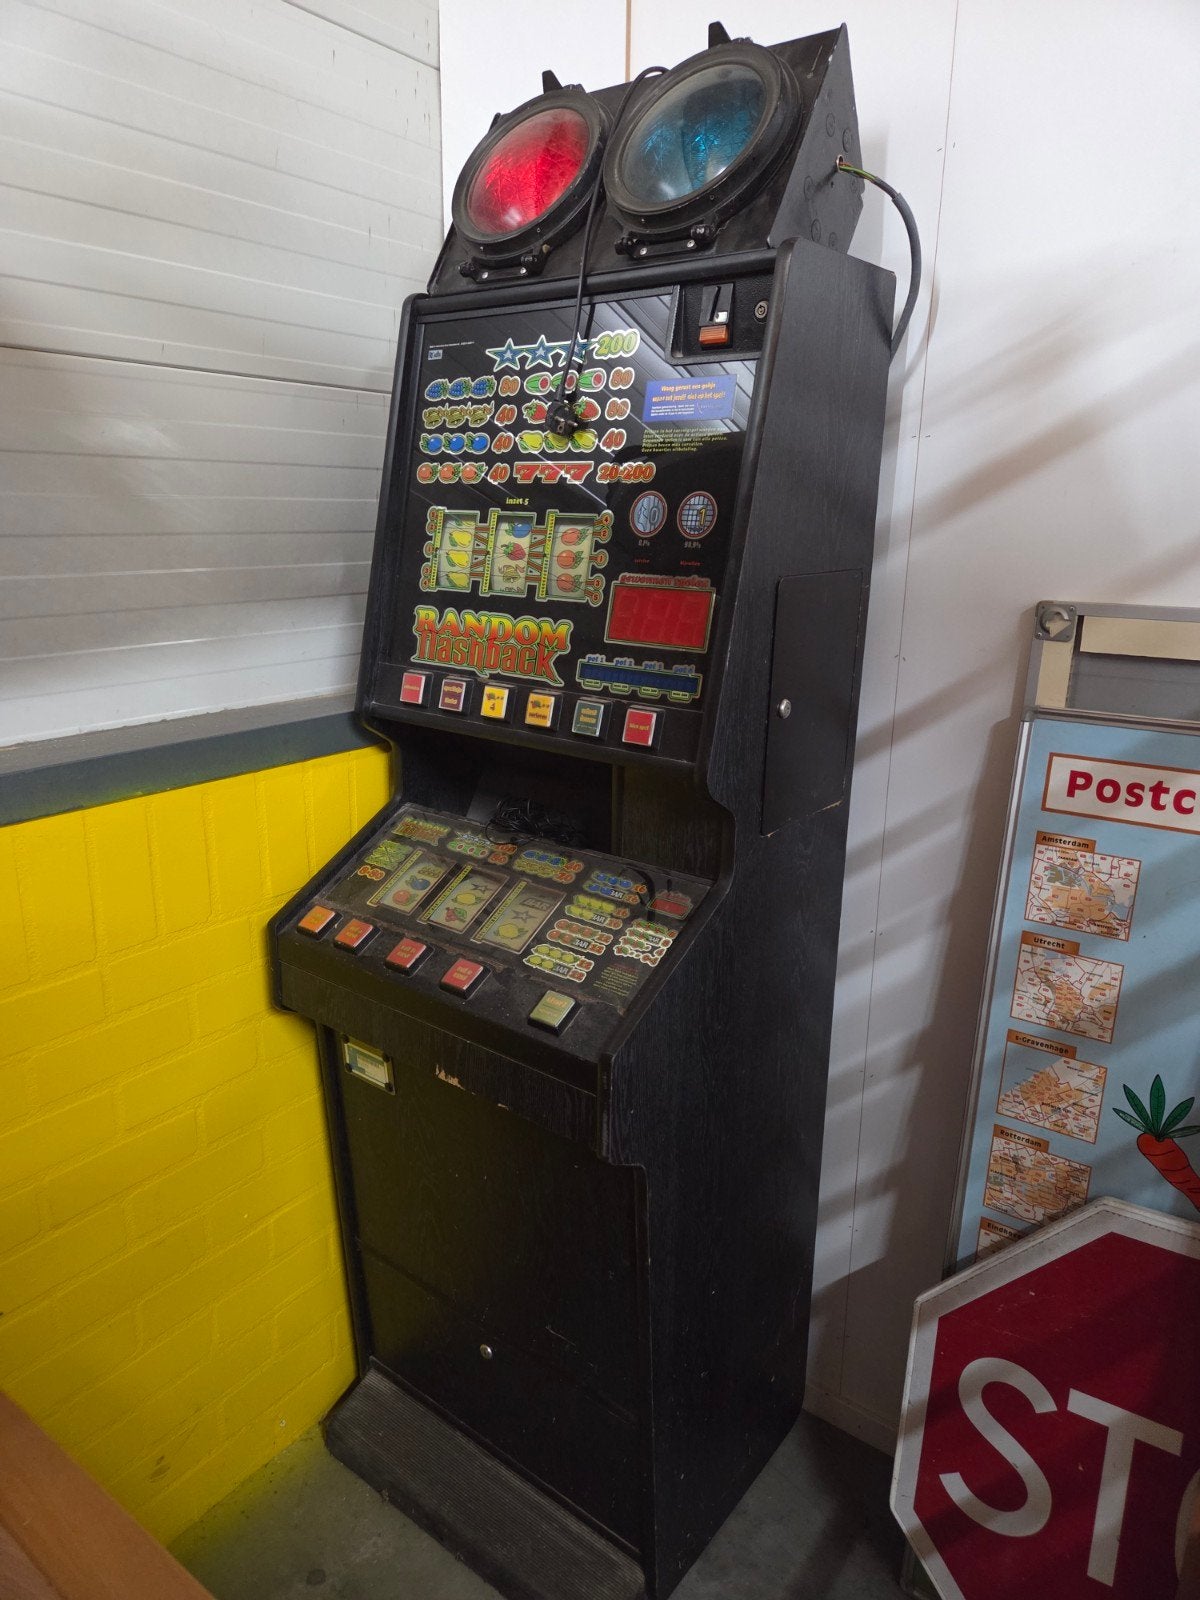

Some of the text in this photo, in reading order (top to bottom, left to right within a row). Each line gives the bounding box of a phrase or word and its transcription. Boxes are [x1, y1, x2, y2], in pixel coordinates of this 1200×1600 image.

[595, 330, 638, 358] 200
[610, 368, 633, 389] 80
[606, 398, 630, 419] 80
[600, 429, 625, 451] 40
[598, 463, 655, 482] 20-200
[415, 608, 570, 651] RANDOM
[415, 629, 562, 684] flashback
[587, 655, 599, 663] pot
[615, 658, 627, 667] pot
[644, 662, 656, 670] pot
[489, 703, 496, 711] 4
[1041, 835, 1089, 849] Amsterdam
[1033, 936, 1065, 949] Utrecht
[999, 1129, 1042, 1148] Rotterdam
